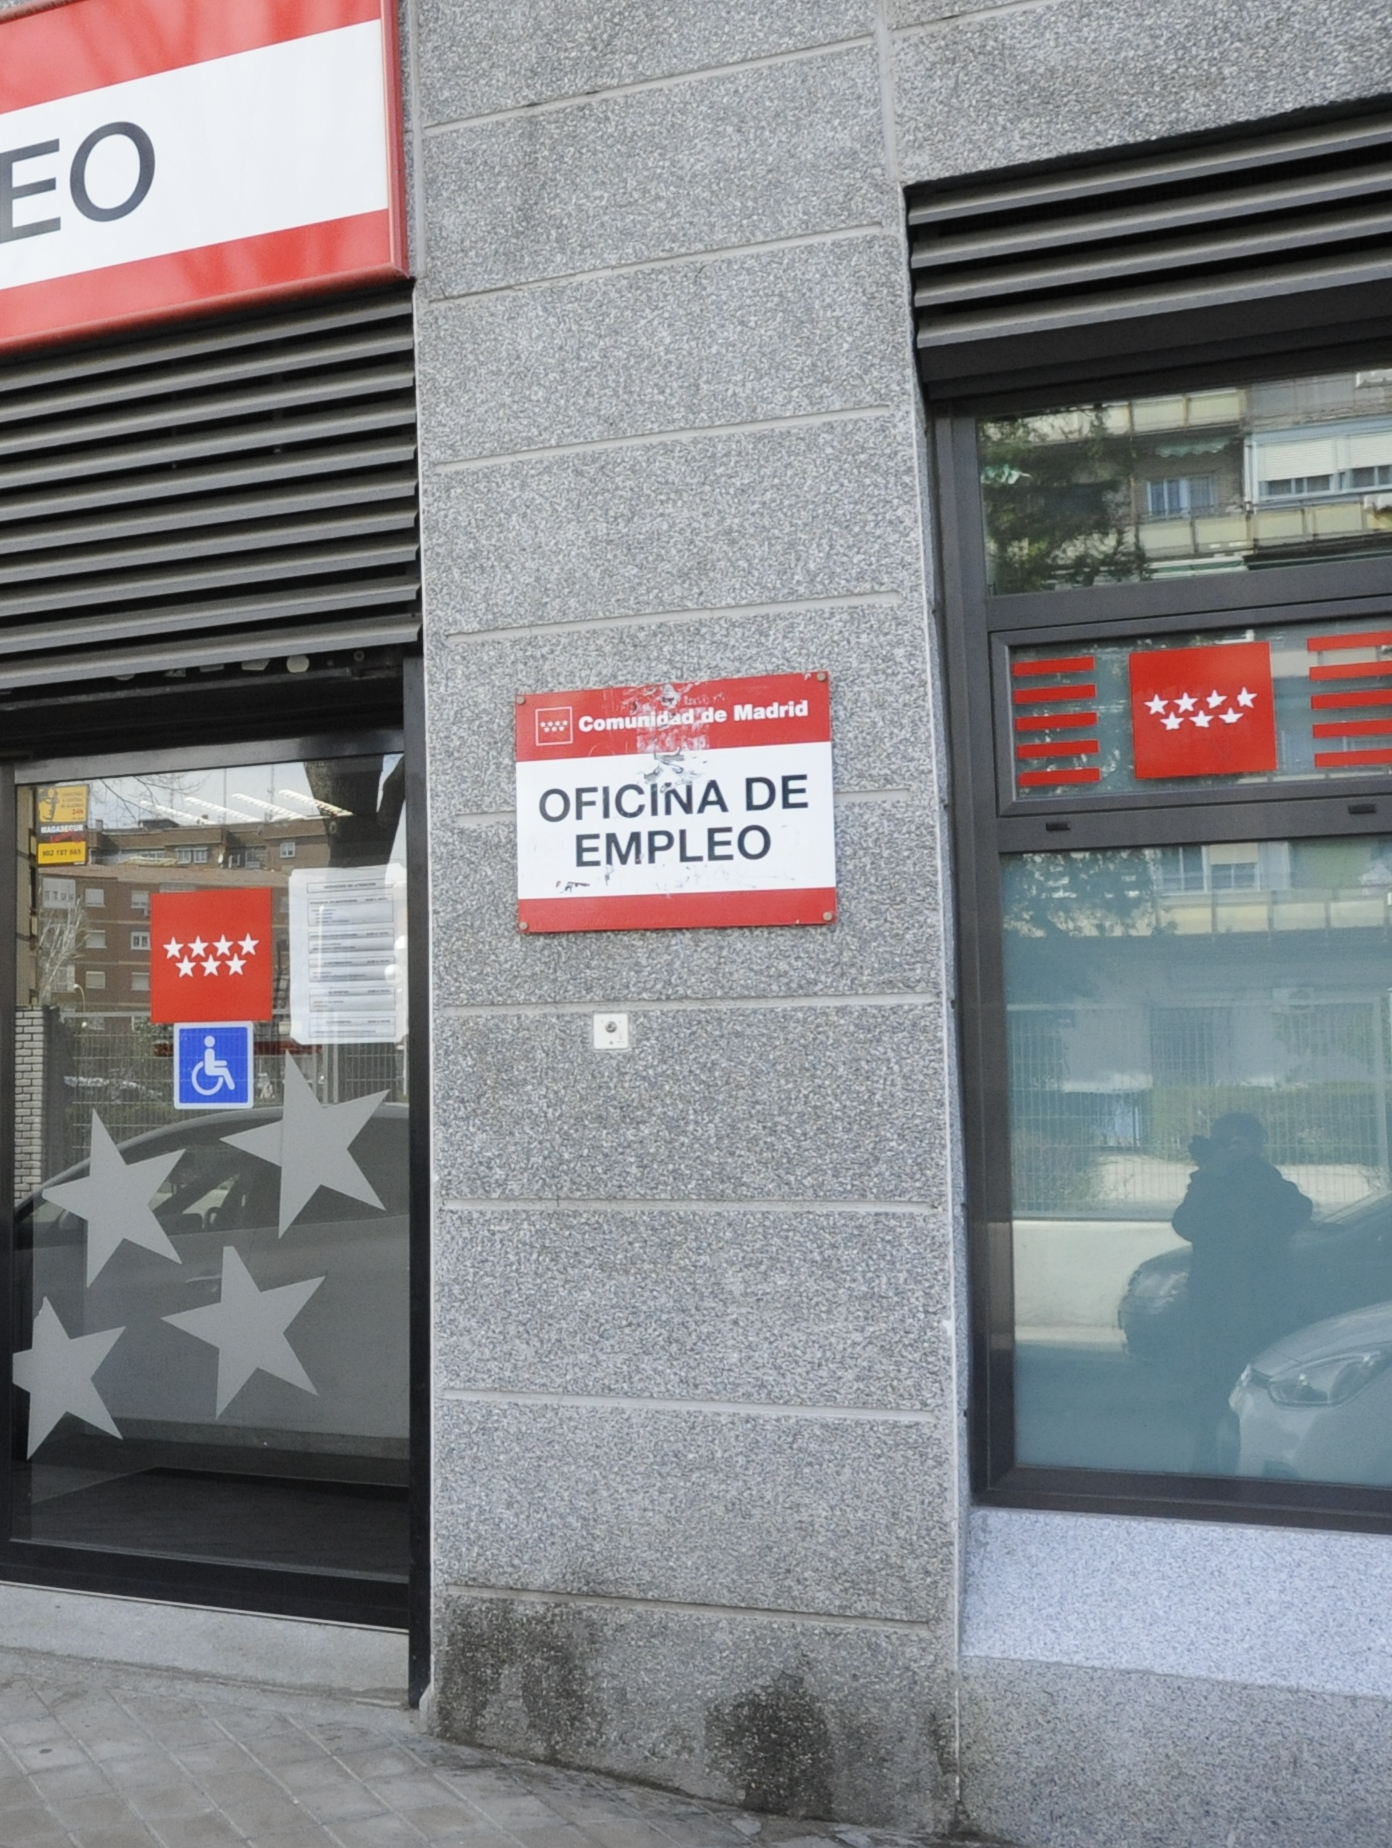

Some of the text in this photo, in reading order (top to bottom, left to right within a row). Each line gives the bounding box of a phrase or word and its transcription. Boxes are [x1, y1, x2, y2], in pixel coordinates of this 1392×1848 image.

[578, 700, 808, 732] Comunidad de Madrid
[539, 774, 808, 822] OFICINA DE
[575, 824, 772, 867] EMPLEO
